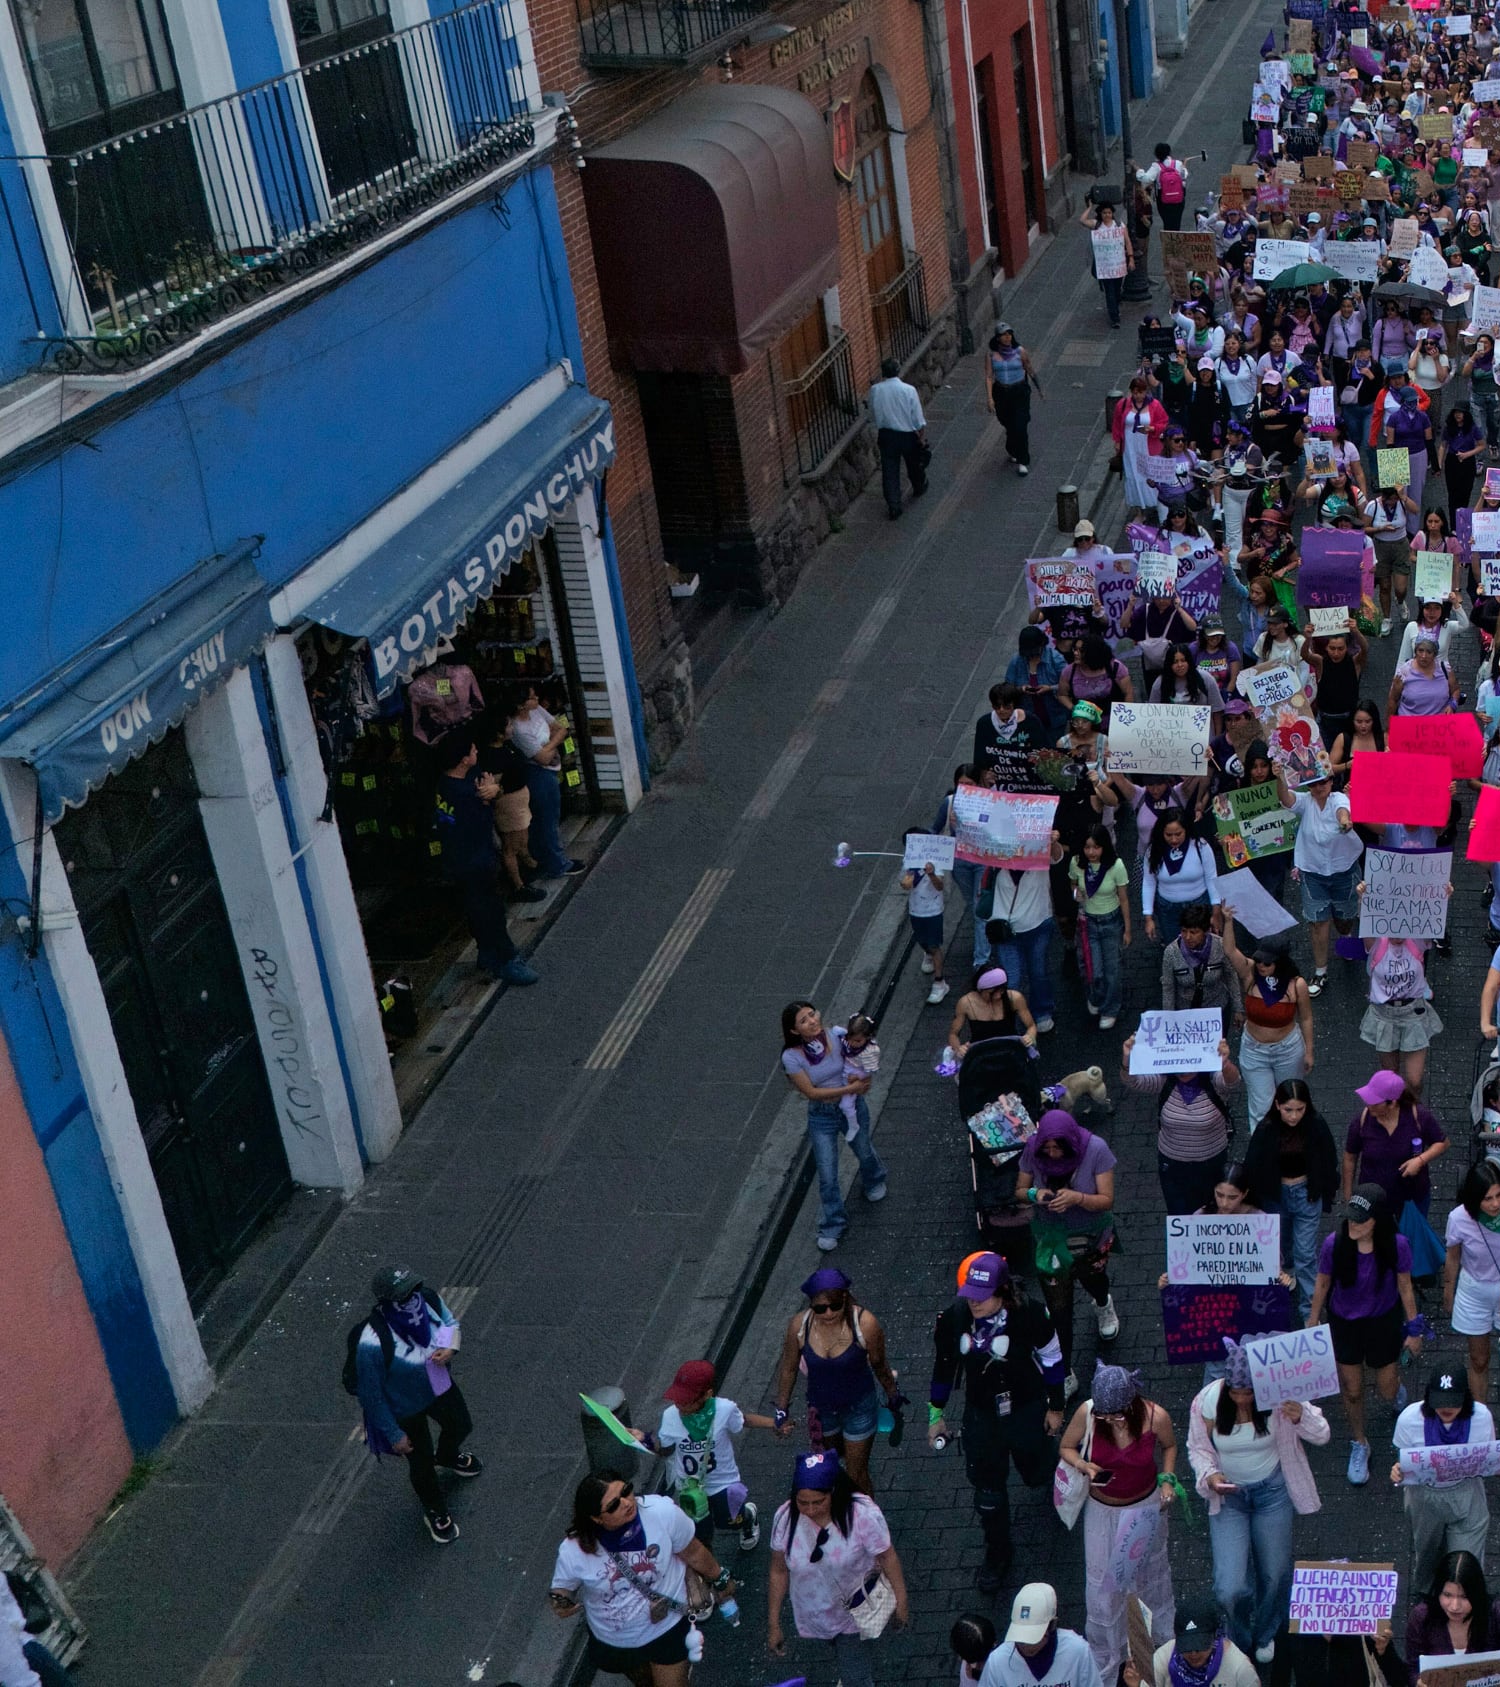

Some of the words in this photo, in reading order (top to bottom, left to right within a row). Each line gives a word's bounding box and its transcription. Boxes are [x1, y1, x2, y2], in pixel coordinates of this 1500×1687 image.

[547, 420, 616, 504] CHUY
[1040, 565, 1066, 576] QUIEN
[1074, 565, 1090, 575] AMA
[374, 554, 485, 679] BOTAS
[487, 499, 546, 571] DON
[178, 629, 229, 691] CHUY
[1259, 685, 1293, 704] APAGUES
[101, 689, 151, 754] DON
[998, 756, 1012, 765] DE
[994, 764, 1027, 774] QUIEN
[1236, 786, 1272, 804] NUNCA
[1400, 852, 1415, 874] la
[1365, 878, 1383, 896] de
[1391, 877, 1410, 898] las
[1362, 896, 1385, 914] que
[1388, 958, 1411, 974] FIND
[1384, 971, 1416, 985] YOUR
[1165, 1020, 1182, 1034] LA
[1185, 1018, 1222, 1033] SALUD
[1165, 1031, 1215, 1045] MENTAL
[1152, 1057, 1203, 1067] RESISTENCIA
[1196, 1222, 1251, 1237] INCOMODA
[1192, 1242, 1225, 1255] VERLO
[1229, 1242, 1243, 1254] EN
[1253, 1330, 1328, 1366] VIVAS
[1455, 1447, 1468, 1456] LO
[1472, 1444, 1490, 1455] QUE
[1294, 1569, 1339, 1585] LUCHA
[1340, 1572, 1397, 1587] AUNQUE
[1307, 1587, 1356, 1604] TENGAS
[1291, 1604, 1313, 1618] POR
[1315, 1604, 1350, 1618] TODAS
[1350, 1604, 1370, 1617] LAS
[1372, 1604, 1390, 1618] QUE
[1303, 1620, 1319, 1632] NO
[1322, 1620, 1336, 1632] LO
[1337, 1619, 1377, 1632] TIENEN
